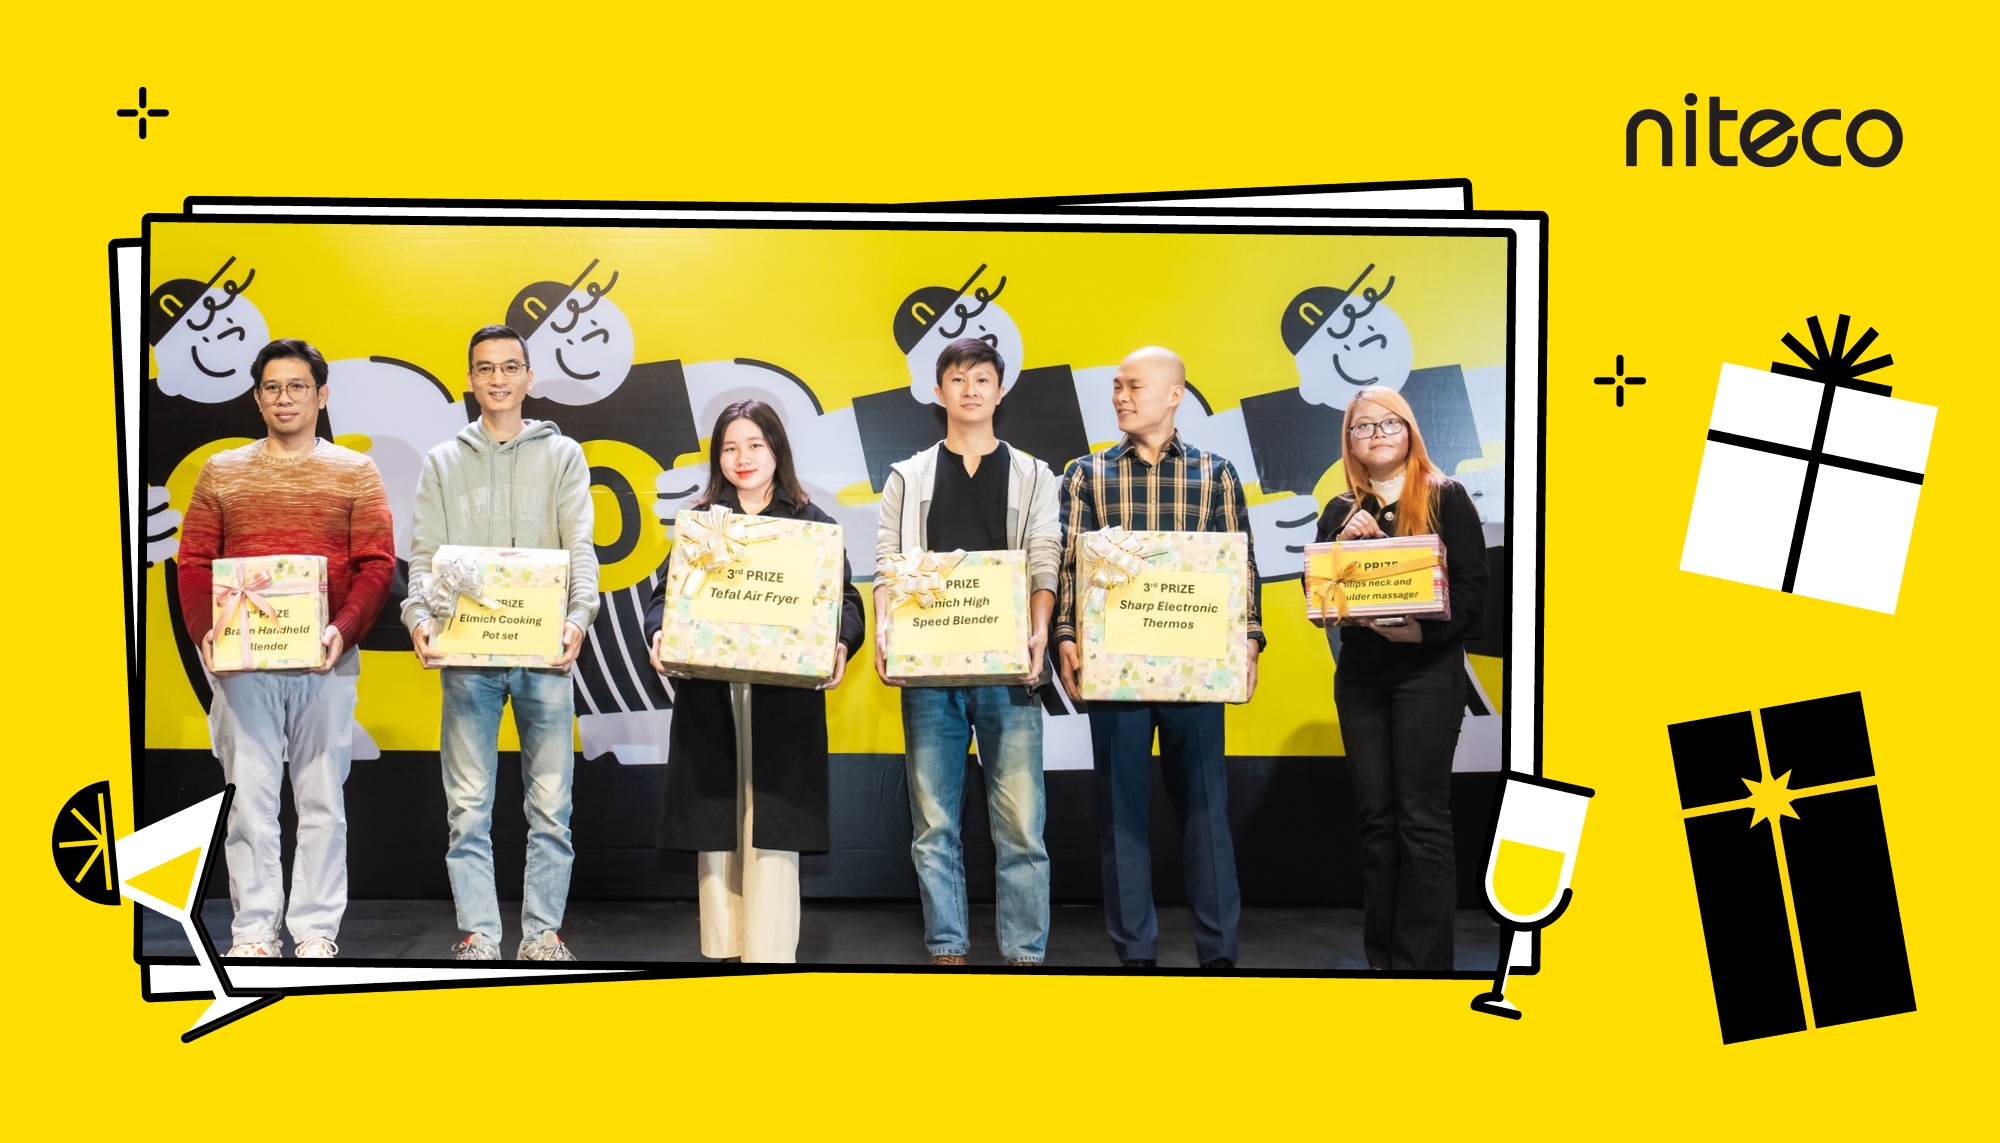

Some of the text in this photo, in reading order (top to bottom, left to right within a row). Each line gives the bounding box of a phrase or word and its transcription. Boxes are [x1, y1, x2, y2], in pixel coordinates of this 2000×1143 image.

[727, 568, 784, 583] 3rd PRIZE
[946, 578, 980, 589] PRIZE
[1143, 582, 1195, 594] 3rd PRIZE
[1368, 578, 1392, 587] neck
[1393, 578, 1412, 586] and
[710, 587, 799, 606] Tefal Air Fryer
[963, 596, 990, 609] High
[1372, 591, 1419, 603] massager
[1119, 599, 1218, 614] Sharp Electronic
[459, 613, 543, 627] Elmich Cooking
[912, 614, 999, 629] Speed Blender
[1142, 617, 1195, 630] Thermos
[224, 626, 256, 637] Bran
[482, 630, 519, 641] Pot set
